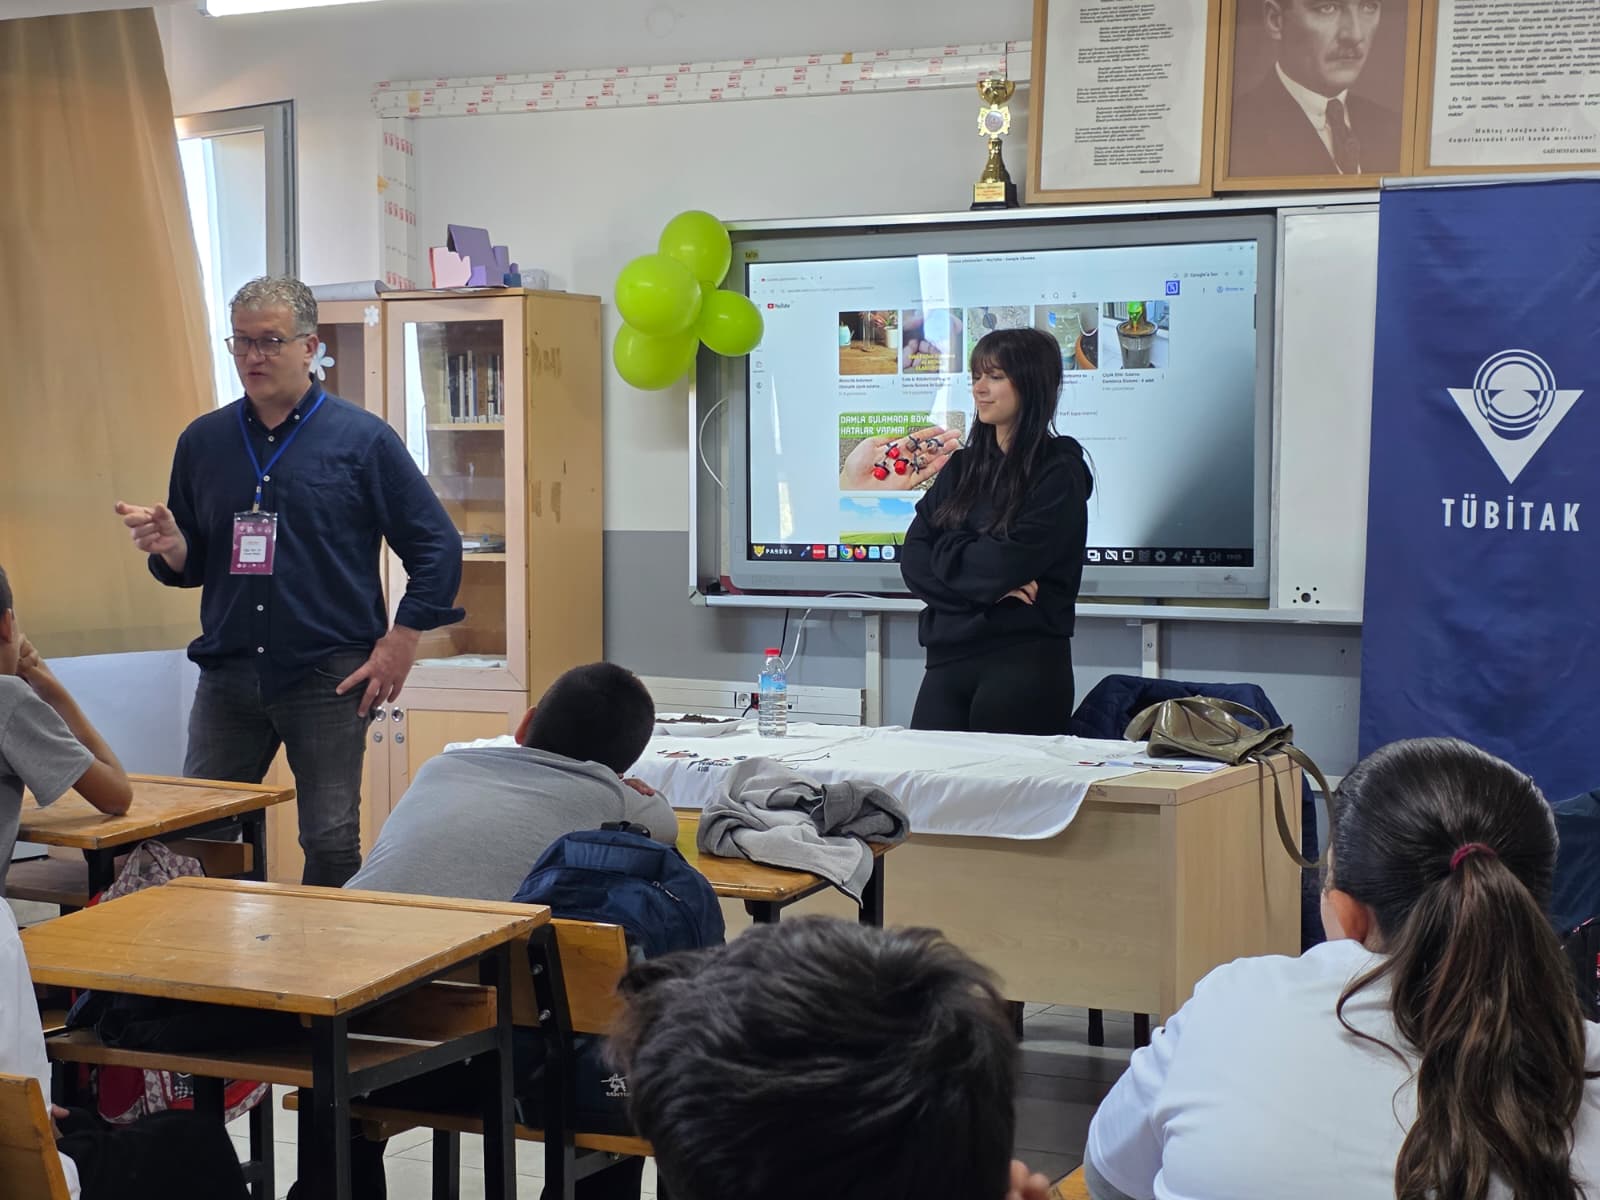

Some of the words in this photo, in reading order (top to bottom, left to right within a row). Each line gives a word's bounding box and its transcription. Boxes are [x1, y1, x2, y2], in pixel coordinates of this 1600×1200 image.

[840, 415, 866, 424] DAMLA
[840, 425, 874, 435] HATALAR
[1442, 493, 1580, 532] TÜBİTAK
